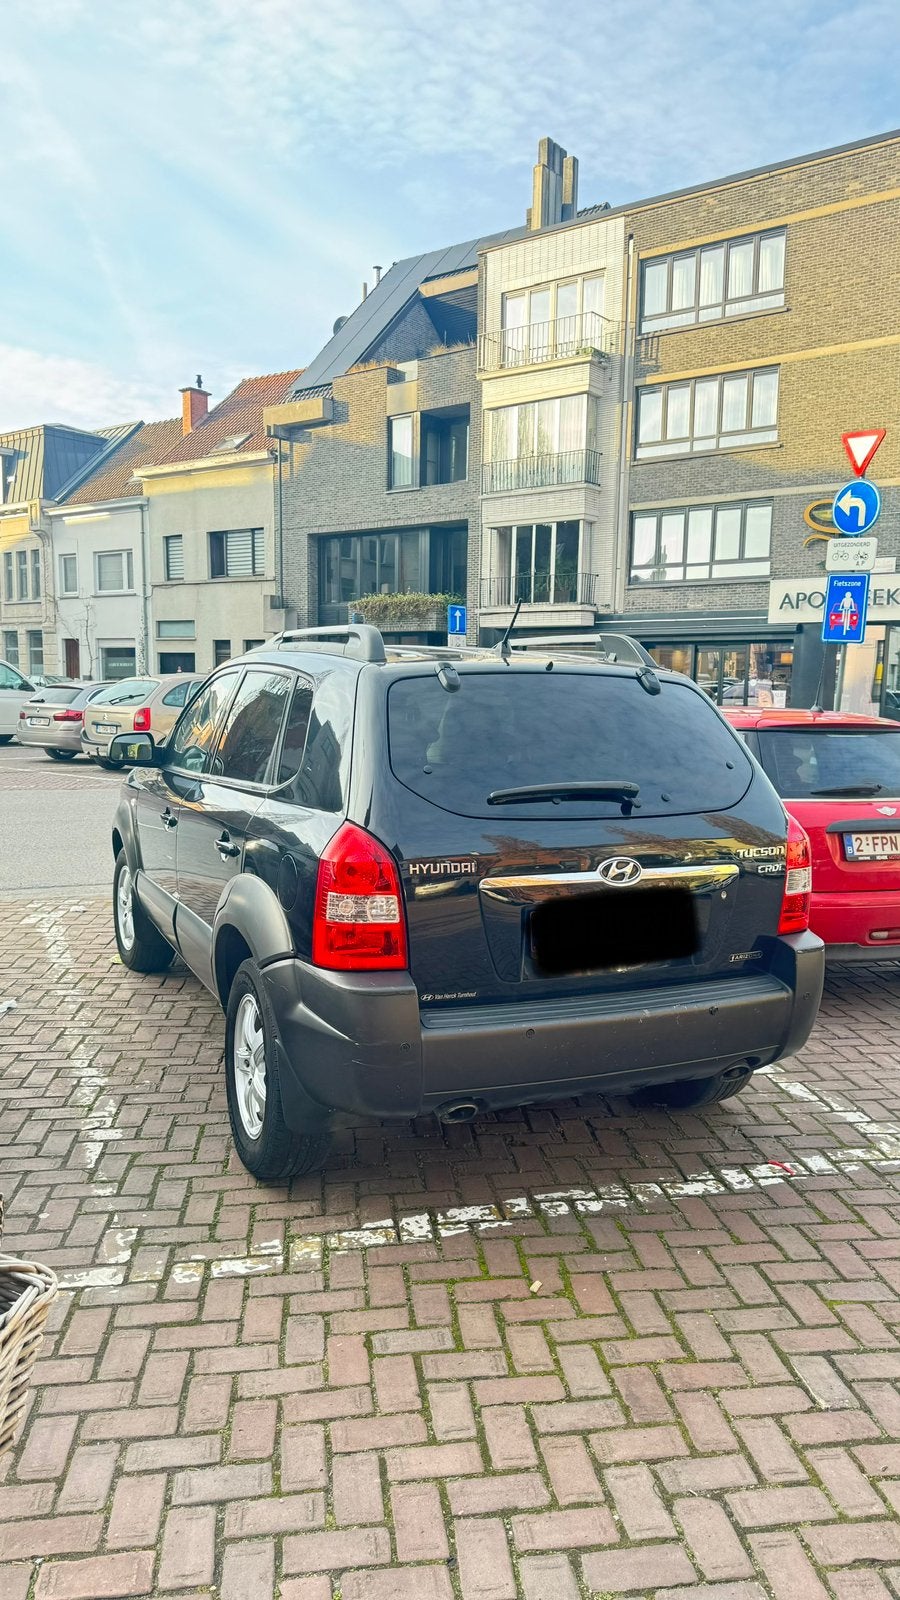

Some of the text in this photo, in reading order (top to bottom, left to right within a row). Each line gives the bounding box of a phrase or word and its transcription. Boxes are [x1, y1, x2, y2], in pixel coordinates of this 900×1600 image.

[779, 588, 900, 610] APOEK
[736, 845, 785, 858] TUCSON
[409, 863, 475, 874] HYUNDAI
